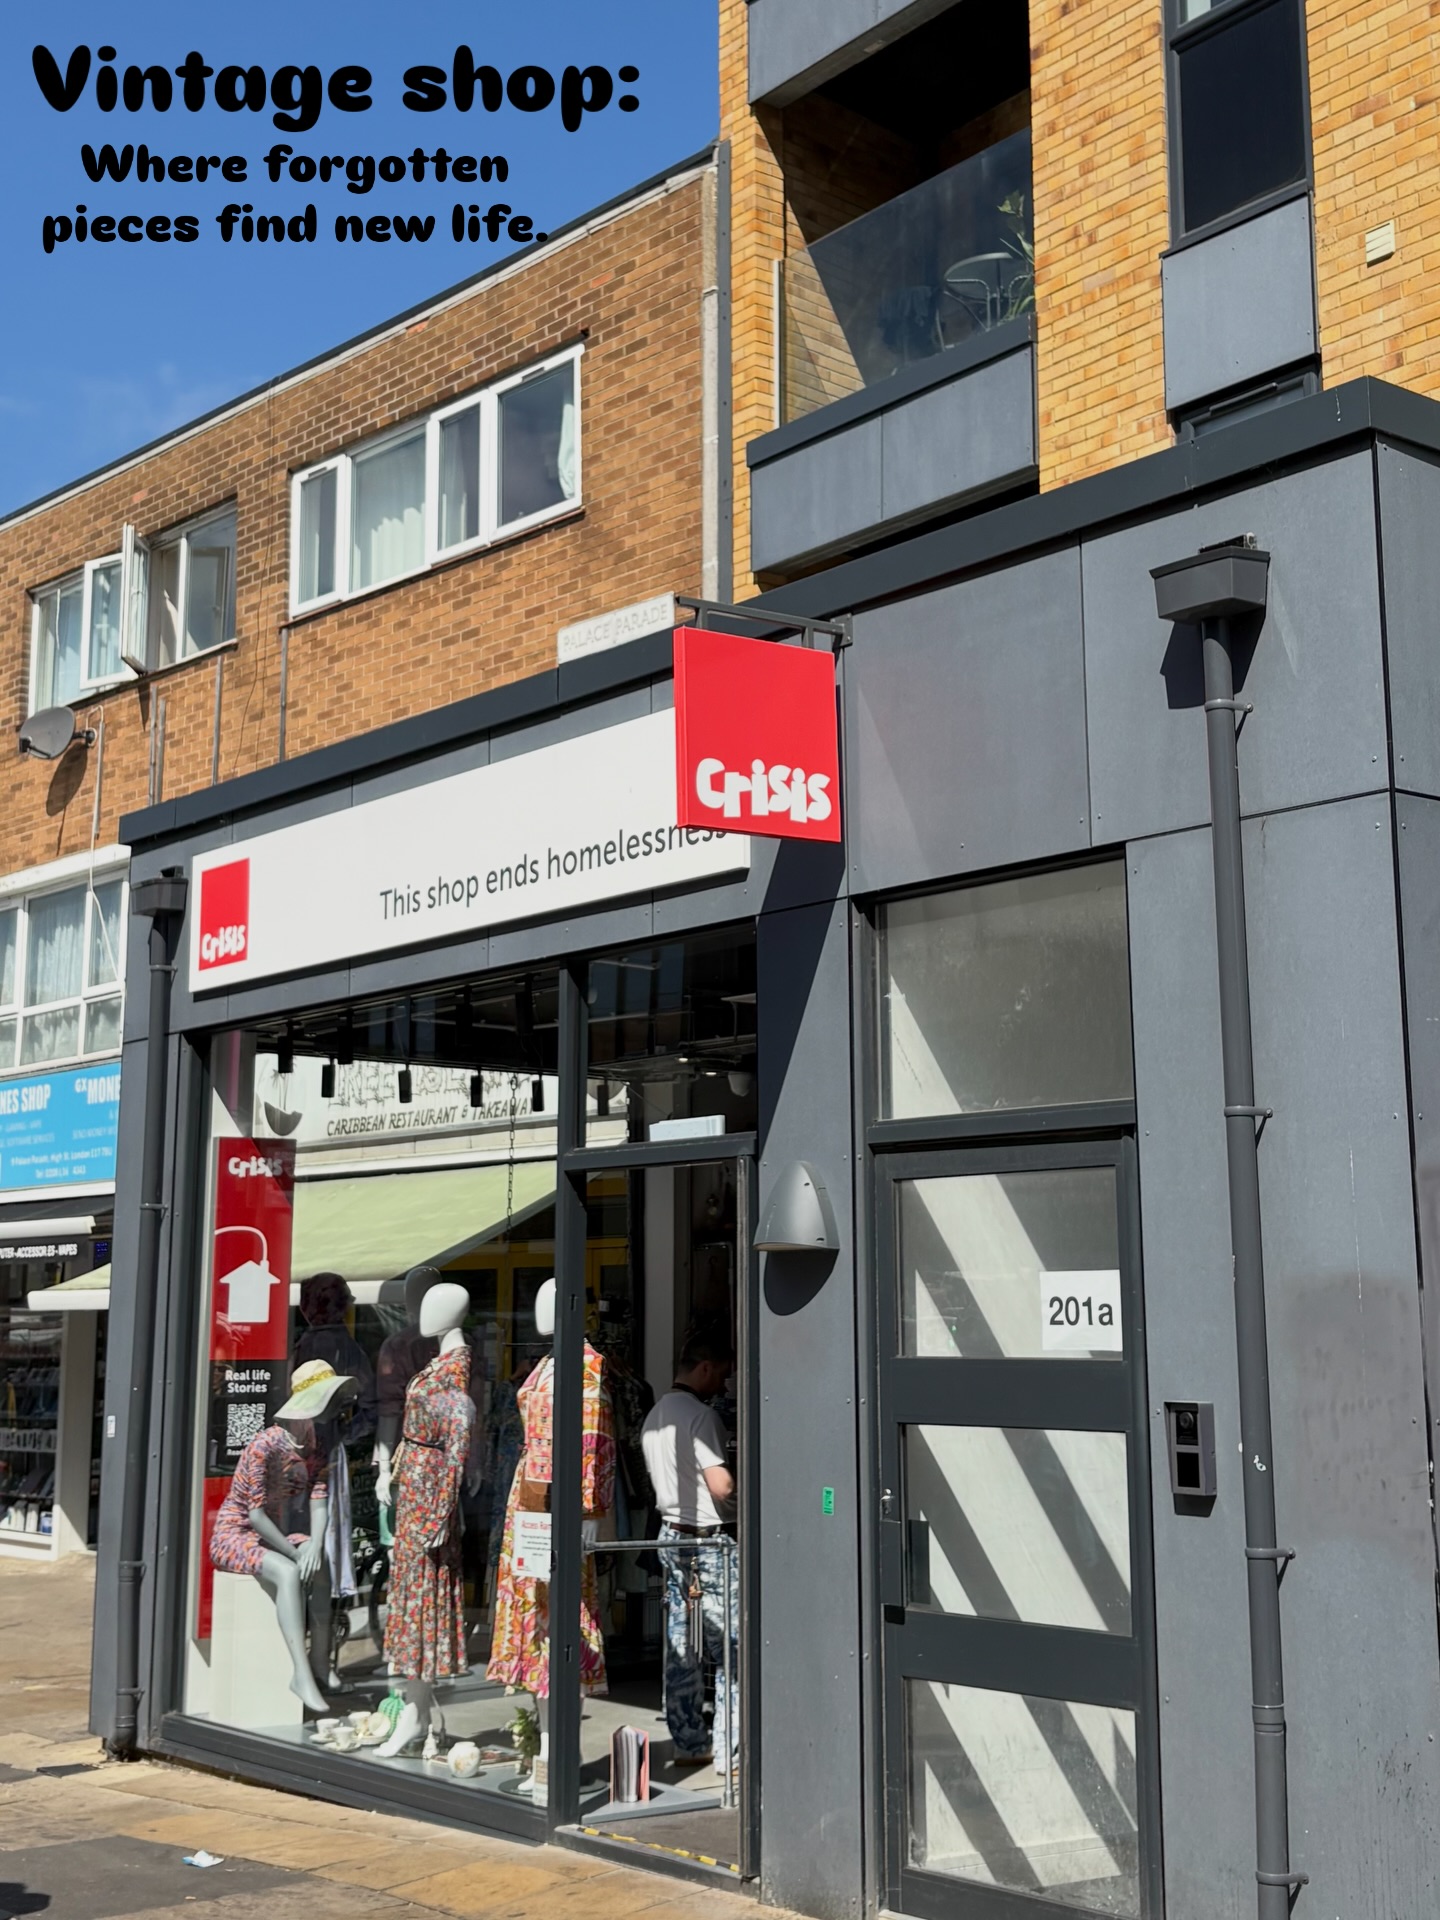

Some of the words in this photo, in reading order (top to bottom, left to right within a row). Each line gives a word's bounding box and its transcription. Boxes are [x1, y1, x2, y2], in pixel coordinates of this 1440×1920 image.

[563, 622, 610, 652] PALACE
[615, 603, 668, 636] PARADE
[696, 758, 832, 823] Crisis
[379, 884, 421, 920] This
[427, 876, 479, 908] shop
[486, 853, 539, 894] ends
[202, 924, 247, 963] Crisis
[21, 1084, 51, 1112] SHOP
[326, 1113, 388, 1137] CARIBBEAN
[388, 1105, 458, 1130] RESTAURANT
[228, 1155, 283, 1178] Crisis
[1049, 1296, 1113, 1326] 201a
[225, 1369, 250, 1381] Real
[252, 1369, 271, 1381] life
[227, 1382, 268, 1393] Stories
